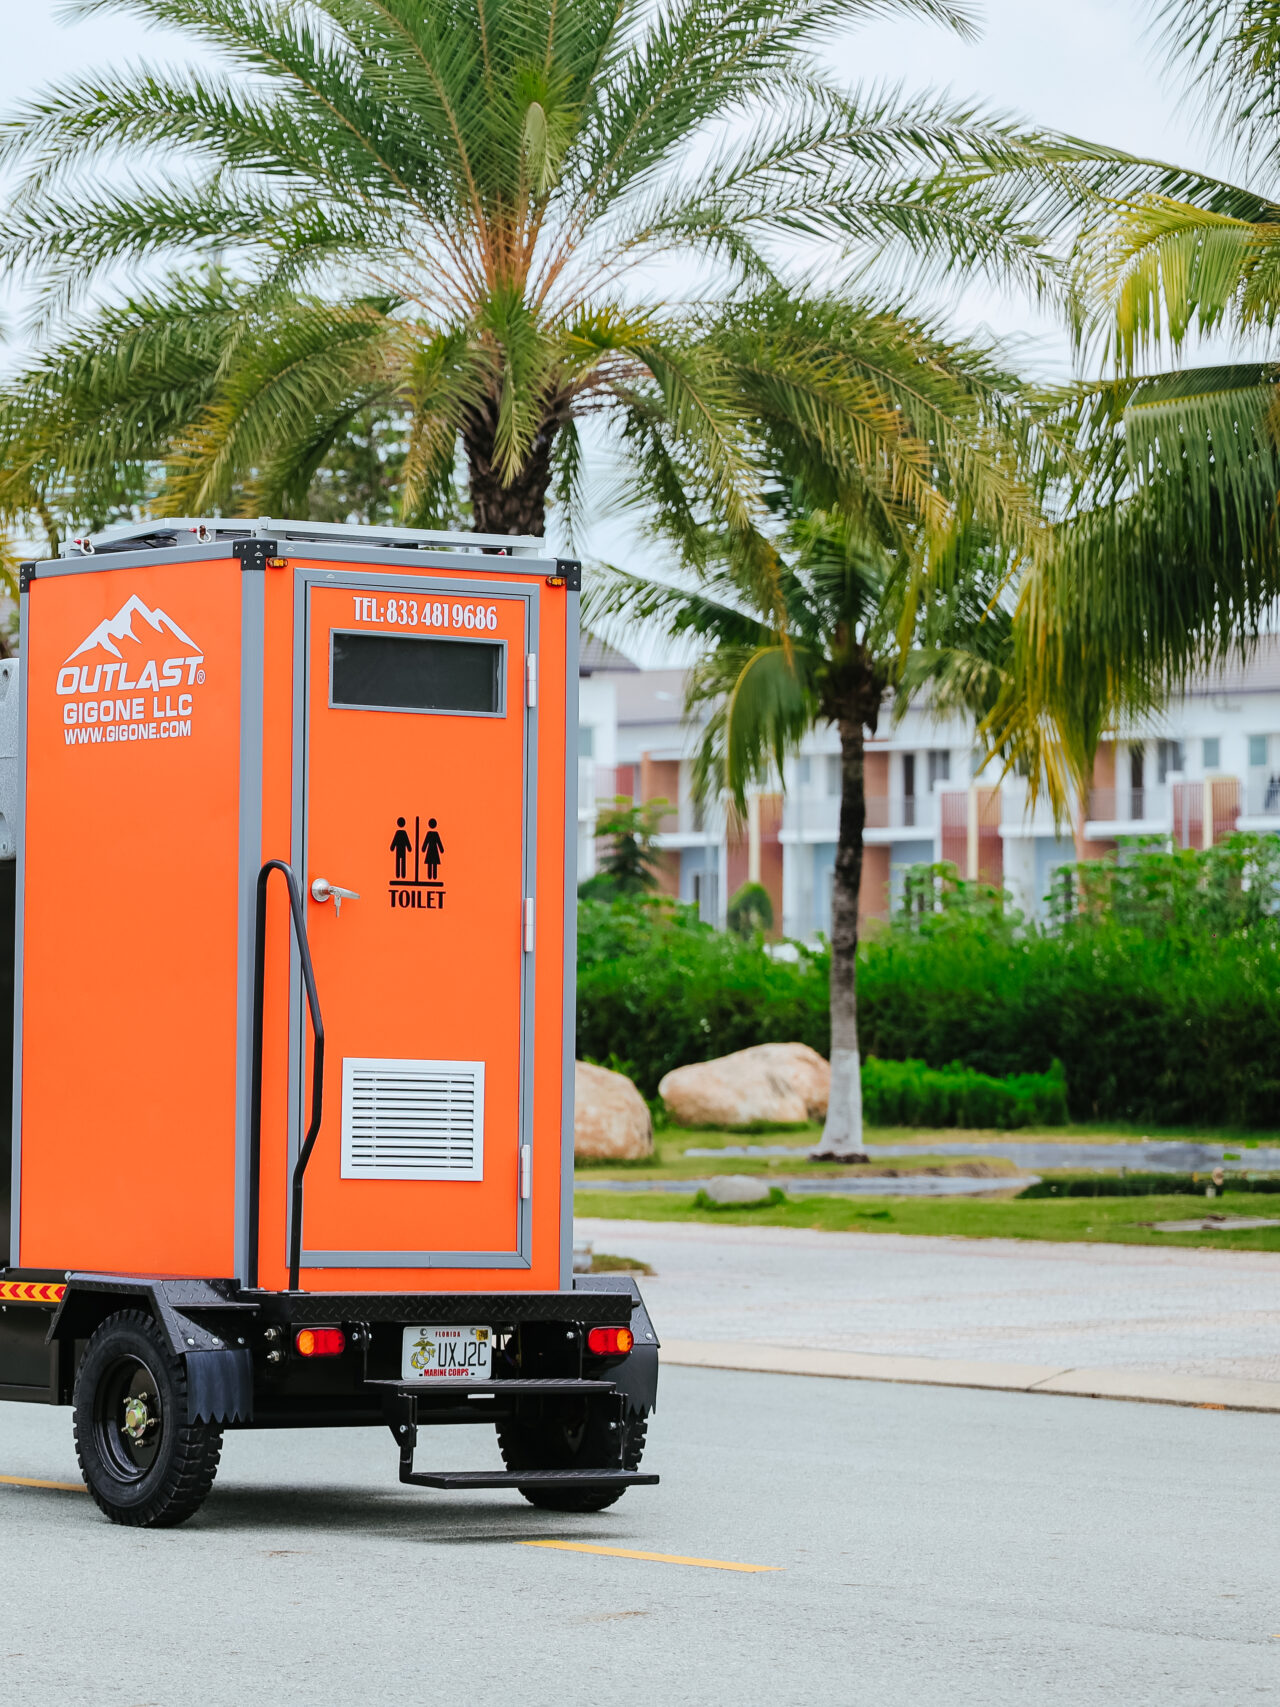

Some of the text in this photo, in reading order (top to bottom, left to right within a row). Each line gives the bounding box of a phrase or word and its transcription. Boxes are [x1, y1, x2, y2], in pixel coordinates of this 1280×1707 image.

[421, 603, 449, 627] 481
[452, 604, 497, 630] 9686
[64, 694, 193, 724] GIGONE LLC
[64, 720, 192, 745] WWW.GIGONE.COM
[388, 889, 446, 909] TOILET
[438, 1342, 487, 1367] UXJ2C
[424, 1368, 469, 1377] MARINE CORPS
